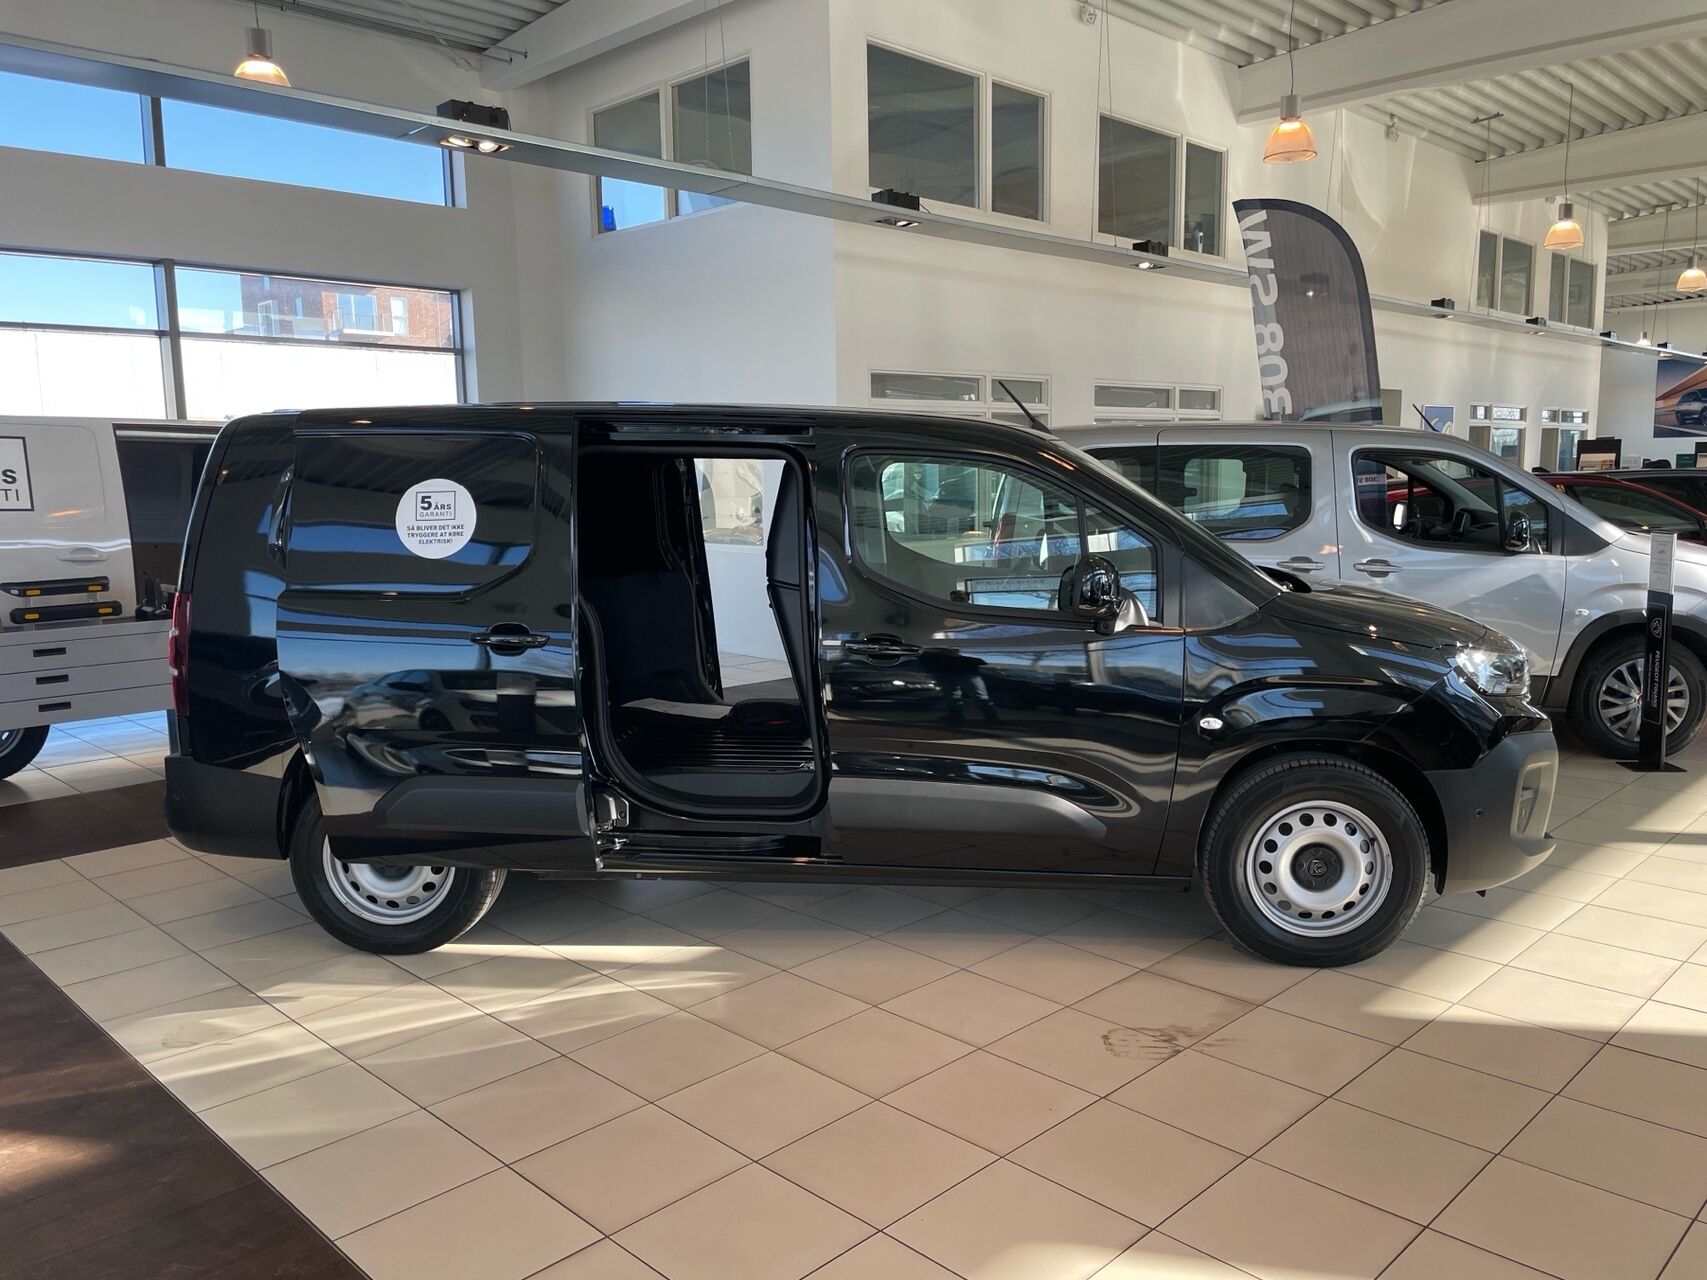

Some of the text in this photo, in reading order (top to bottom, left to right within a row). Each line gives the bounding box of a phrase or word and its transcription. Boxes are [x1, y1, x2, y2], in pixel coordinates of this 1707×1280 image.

[420, 495, 452, 511] 5 ÅRS
[1653, 650, 1661, 682] PEUGEOT
